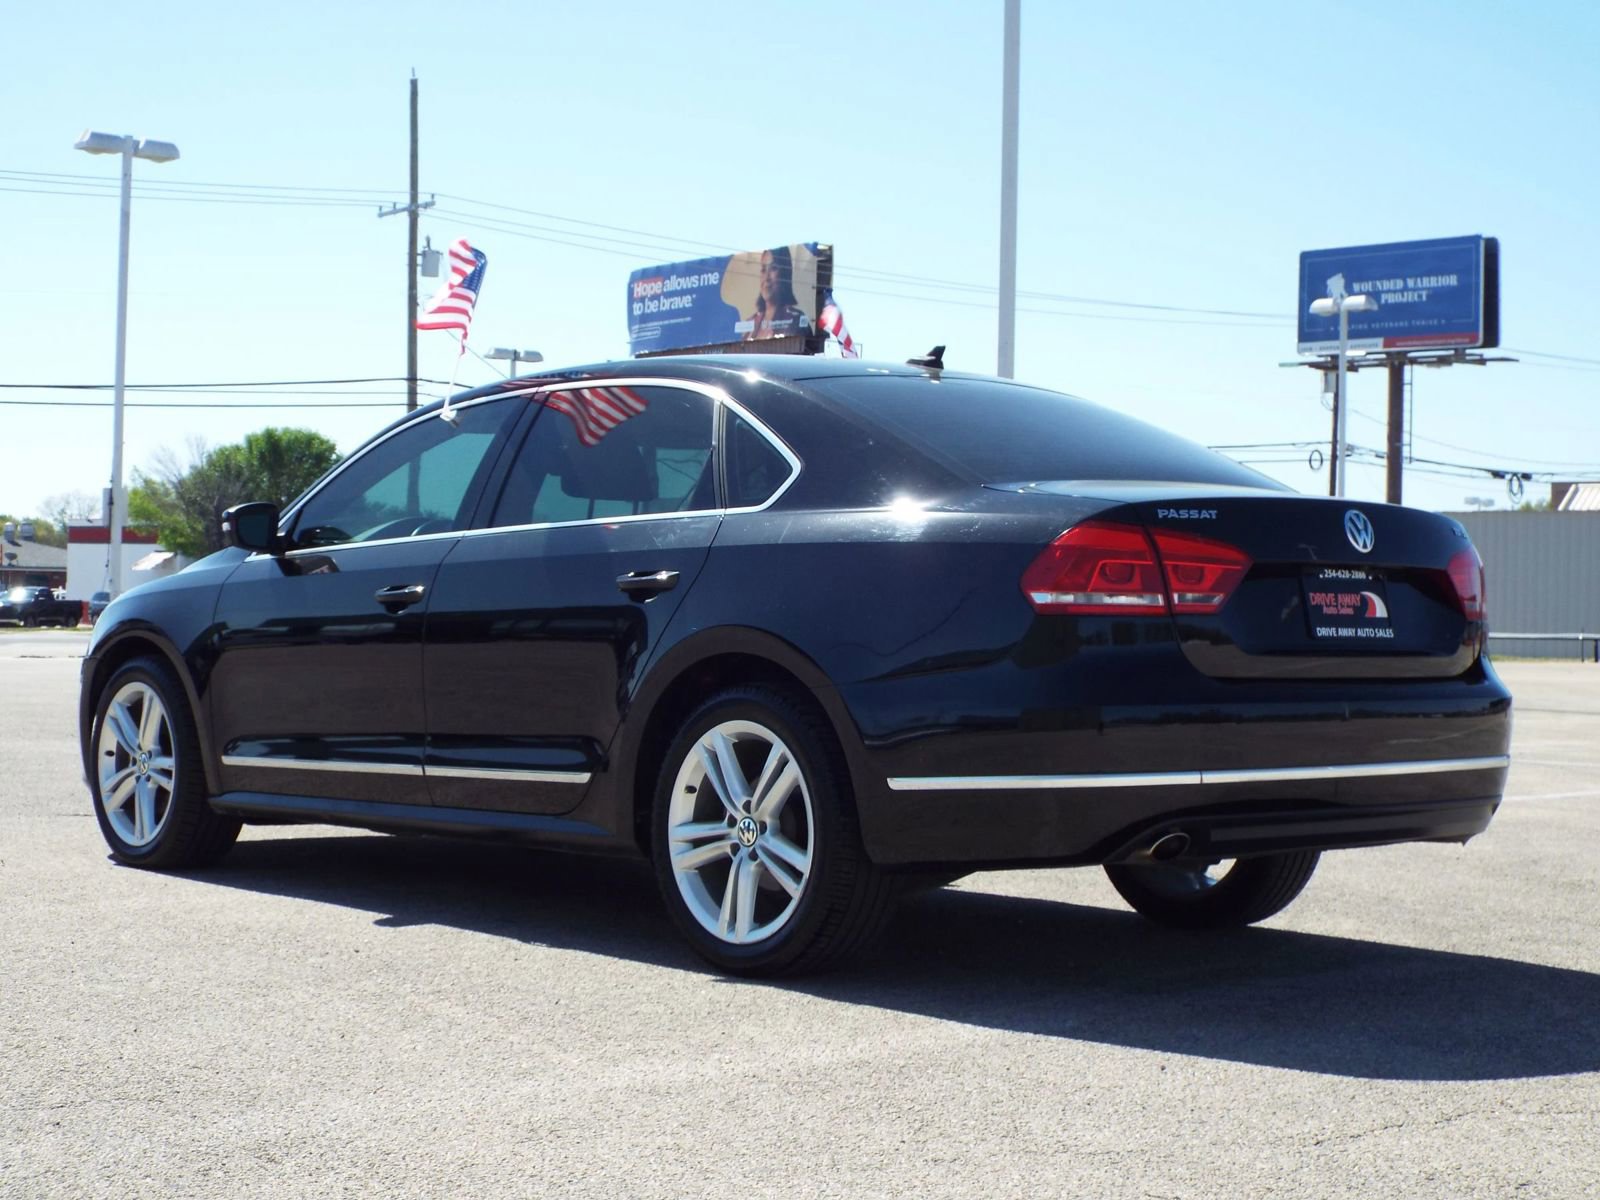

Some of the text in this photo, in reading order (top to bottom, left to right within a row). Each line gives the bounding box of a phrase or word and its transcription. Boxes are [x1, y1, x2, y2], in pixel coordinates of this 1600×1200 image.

[663, 274, 699, 292] allows
[700, 271, 720, 287] me
[1353, 275, 1458, 293] WOUNDED WARRIOR
[632, 301, 643, 316] to
[644, 297, 659, 314] be
[1157, 508, 1218, 519] PASSAT
[1310, 592, 1361, 607] DRIVE AWAY
[1316, 627, 1394, 638] DRIVE AWAY AUTO SALES
